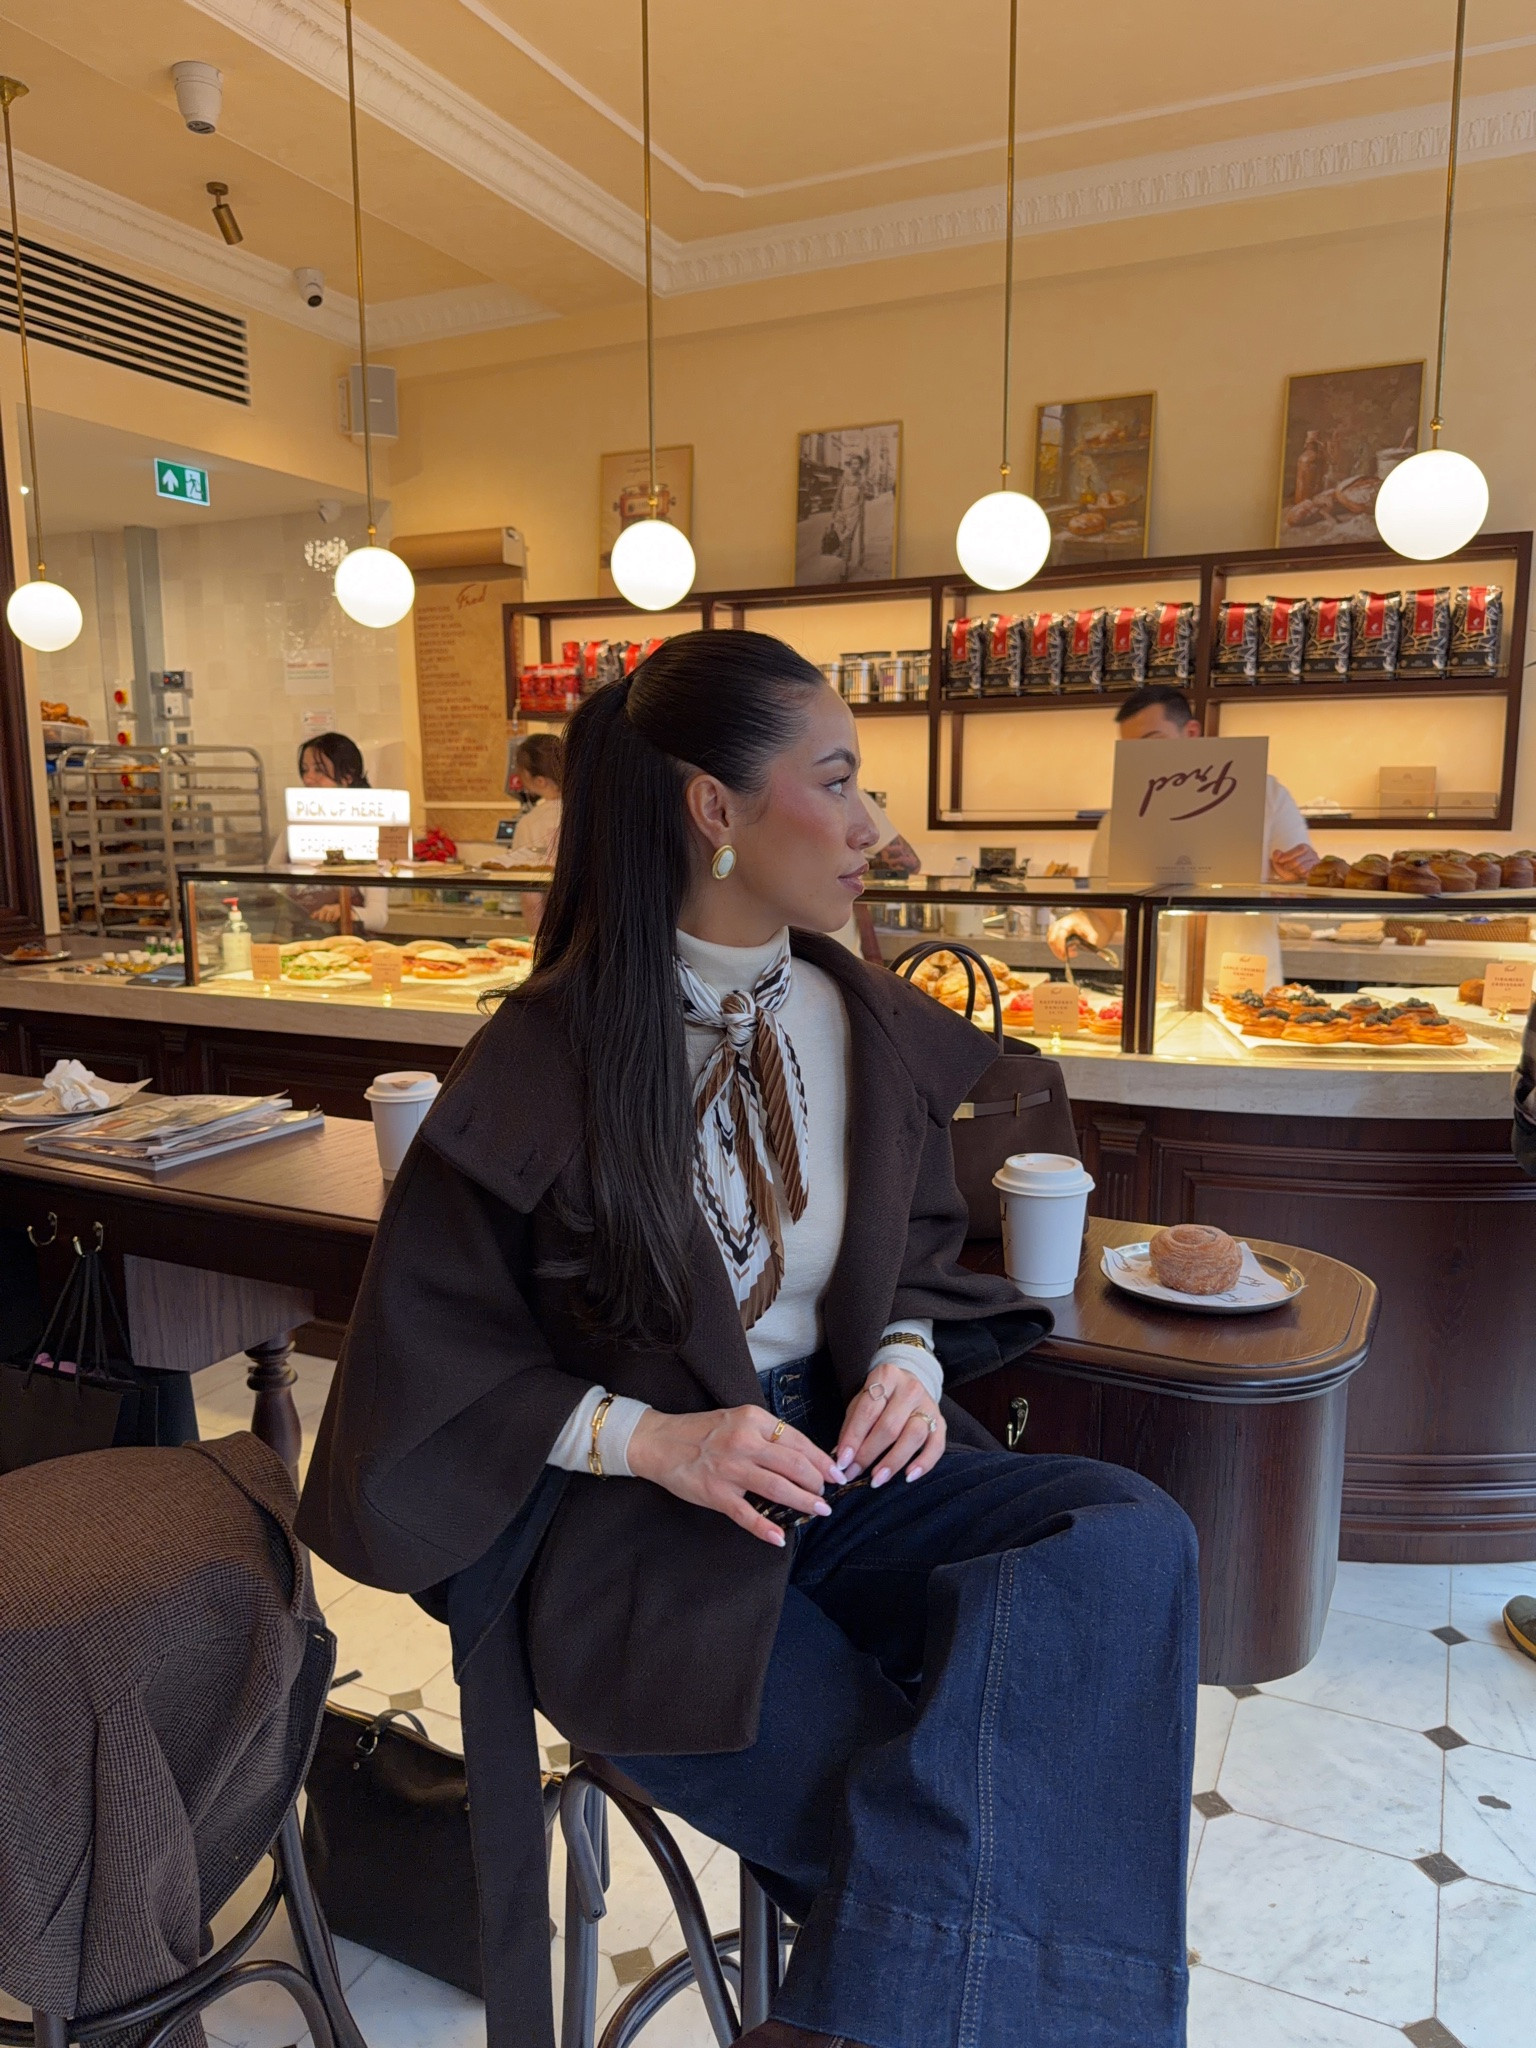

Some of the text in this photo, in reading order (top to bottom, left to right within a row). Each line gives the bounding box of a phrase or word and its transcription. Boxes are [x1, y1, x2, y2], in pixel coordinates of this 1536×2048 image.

[296, 800, 326, 816] PICK
[351, 801, 385, 818] HERE
[1139, 760, 1237, 821] Fred
